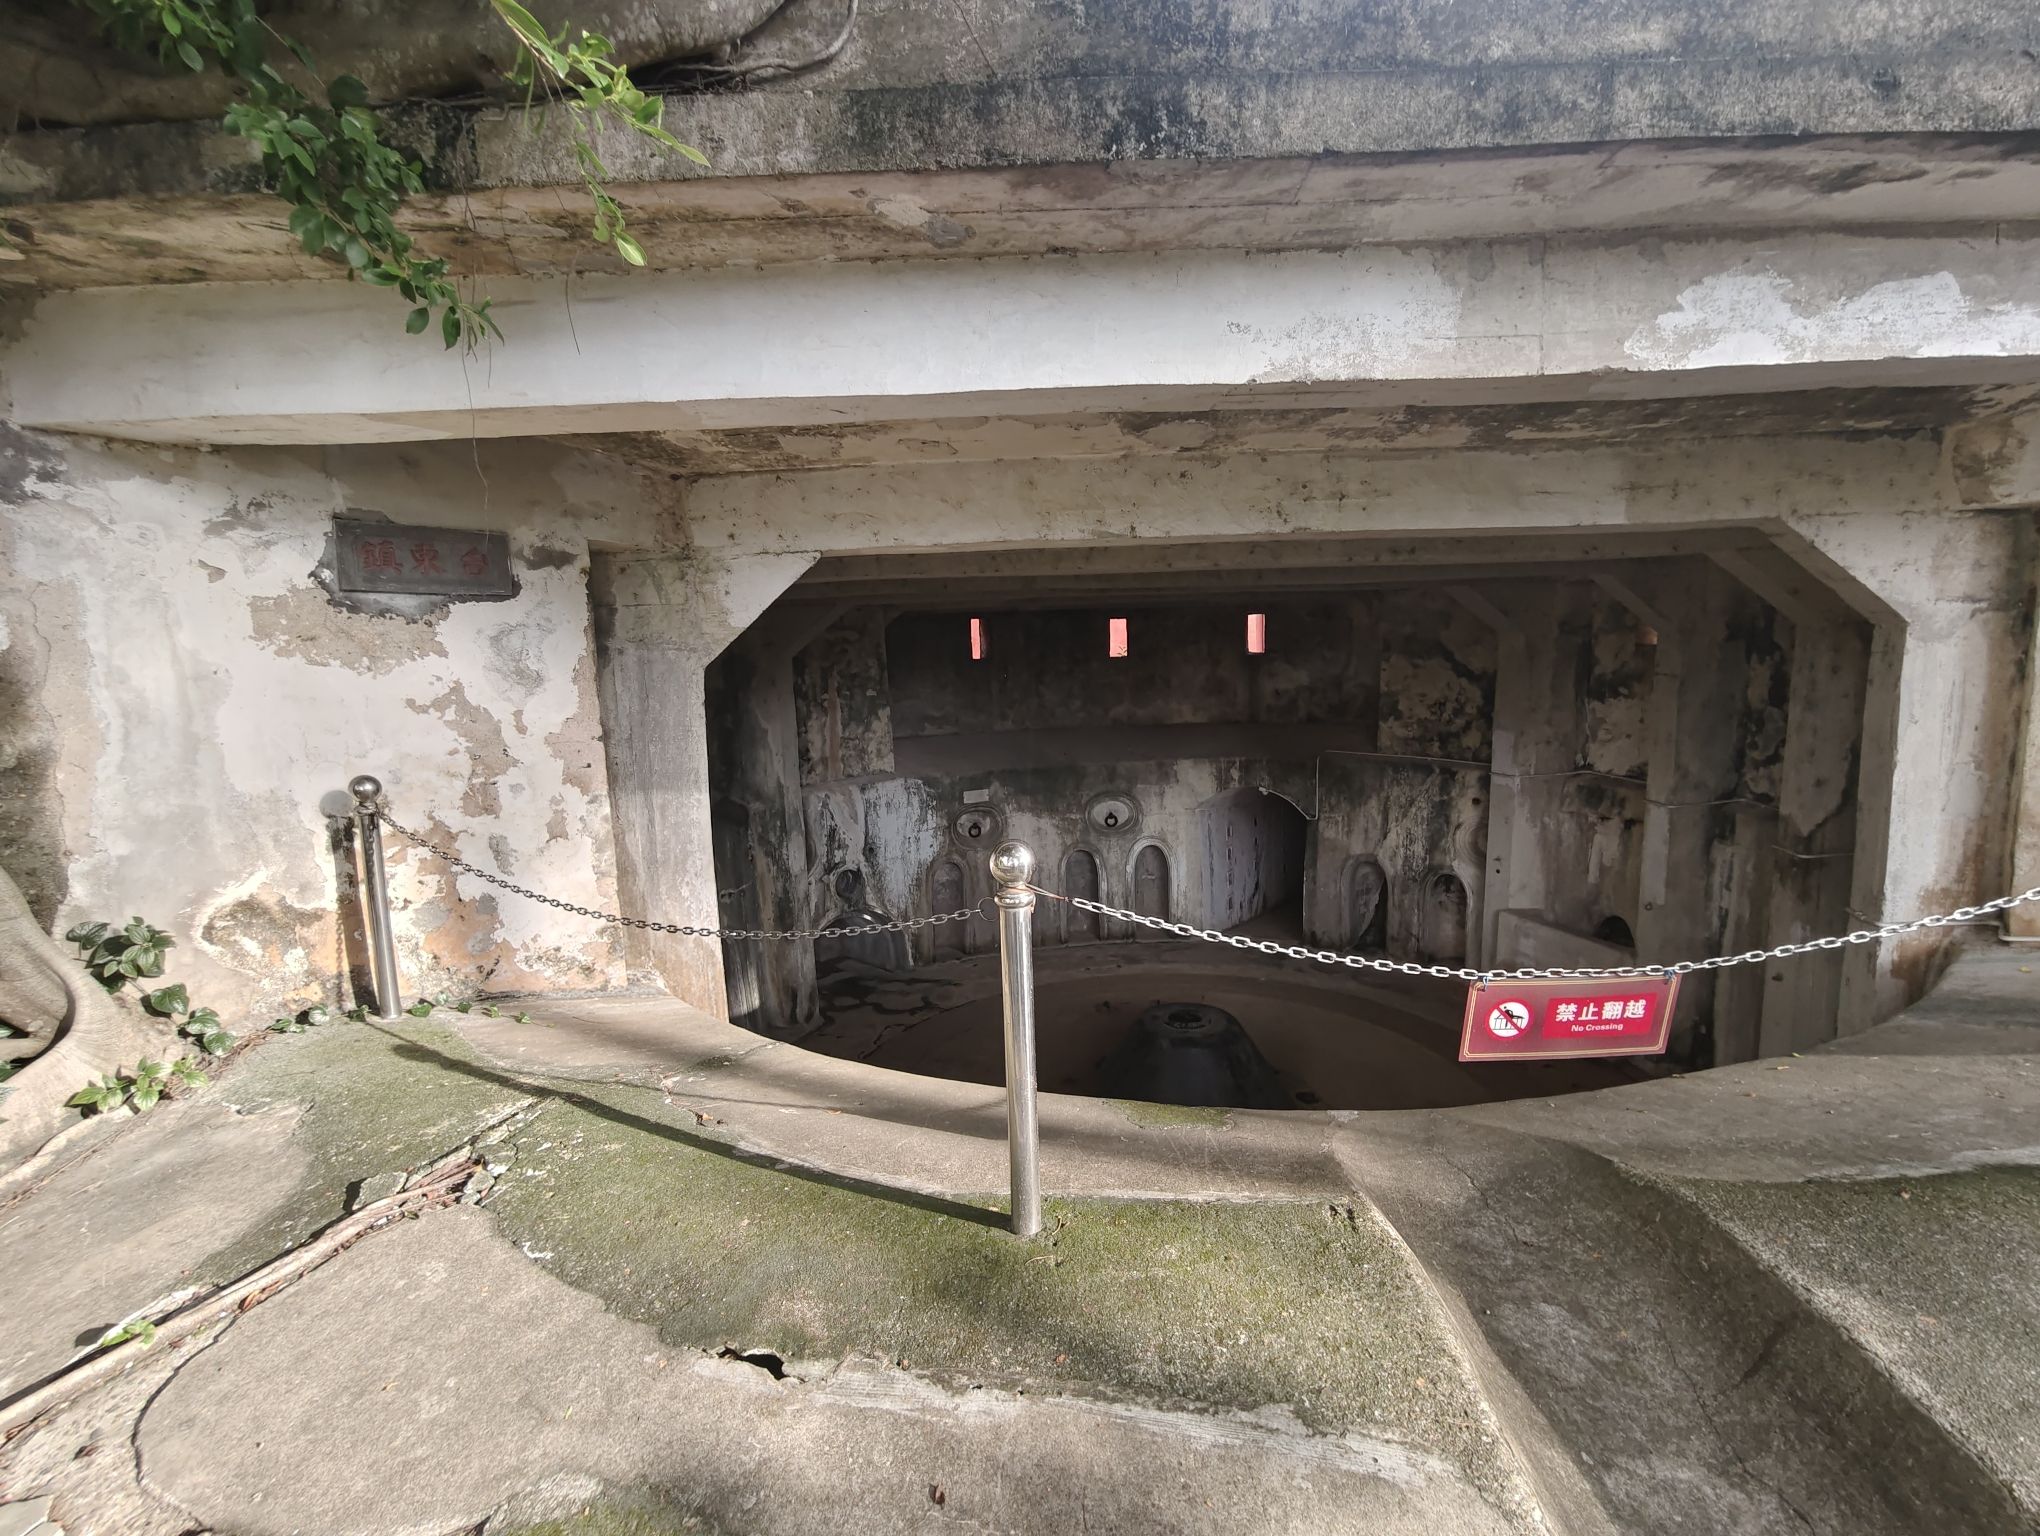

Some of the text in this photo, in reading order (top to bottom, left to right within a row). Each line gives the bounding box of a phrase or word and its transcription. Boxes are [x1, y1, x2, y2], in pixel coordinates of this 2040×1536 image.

[1555, 999, 1646, 1022] 禁止翻越
[1571, 1023, 1624, 1032] No Crossing
